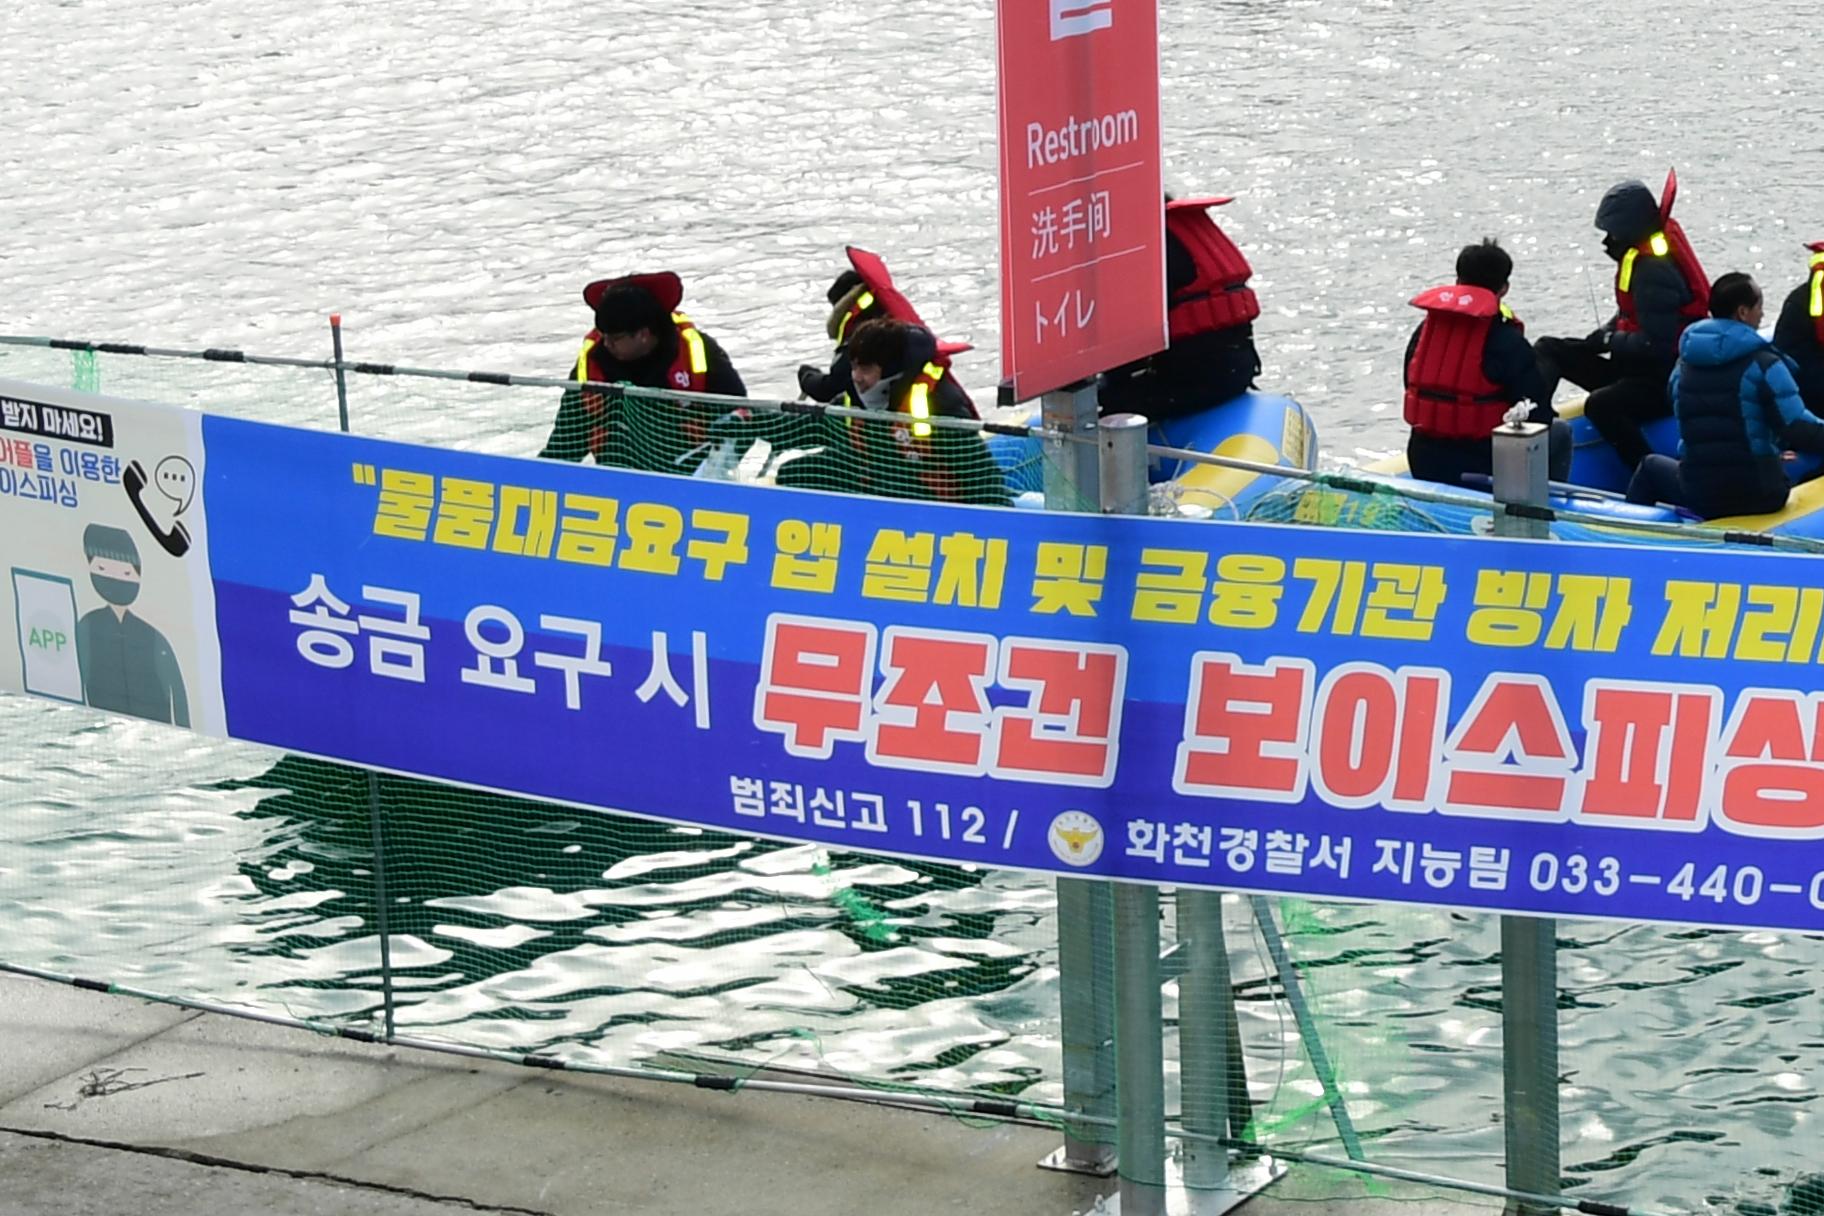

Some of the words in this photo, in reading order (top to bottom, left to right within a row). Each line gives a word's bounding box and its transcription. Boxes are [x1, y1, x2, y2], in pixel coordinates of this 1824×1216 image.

[1026, 107, 1138, 171] Restroom
[1029, 190, 1111, 261] 洗手间
[1034, 288, 1096, 346] トイレ
[0, 399, 38, 431] 받지
[41, 406, 104, 443] 마세요!
[60, 448, 121, 484] 이용한
[352, 463, 749, 581] "물품대금요구
[770, 519, 841, 593] 앱
[862, 528, 1008, 609] 설치
[1030, 541, 1109, 617] 및
[1130, 547, 1446, 641] 금융기관
[1466, 569, 1632, 652] 빙자
[28, 626, 67, 652] APP
[288, 572, 431, 683] 송금
[461, 603, 611, 711] 요구
[635, 630, 711, 729] 시
[755, 614, 1127, 787] 무조건
[729, 774, 888, 833] 범죄신고
[906, 802, 987, 845] 112
[1126, 818, 1353, 879] 화천경찰서
[1372, 837, 1510, 891] 지능팀
